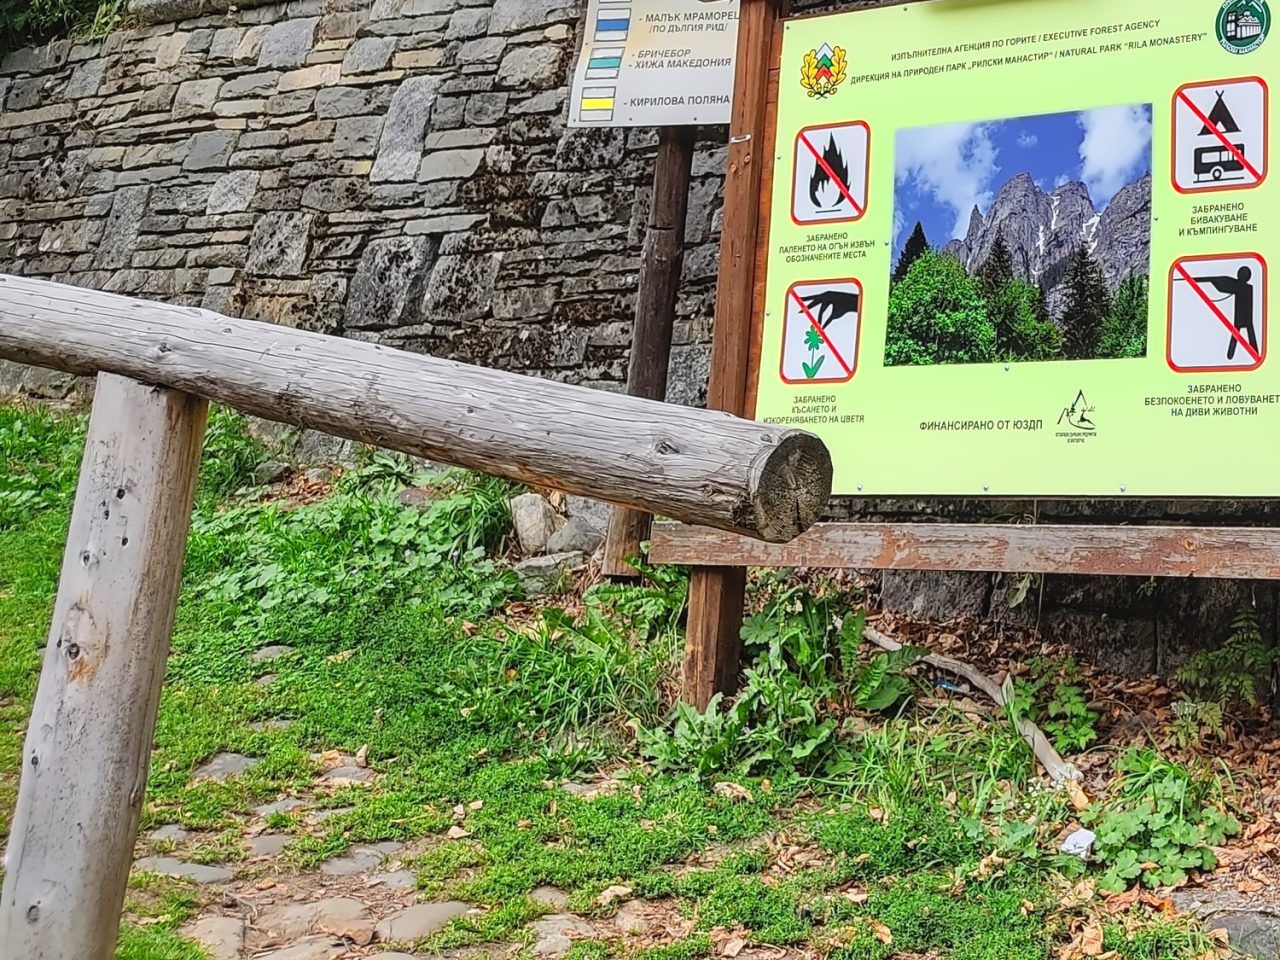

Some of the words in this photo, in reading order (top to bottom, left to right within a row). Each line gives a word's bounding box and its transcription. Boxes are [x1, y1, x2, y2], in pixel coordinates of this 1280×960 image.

[645, 13, 680, 22] МАЛЪК
[668, 24, 703, 33] ДЪЛГИЯ
[891, 46, 952, 62] ИЗПЪЛНИТЕЛНА
[953, 41, 990, 55] АГЕНЦИЯ
[992, 39, 1004, 49] ПО
[1006, 35, 1037, 47] ГОРИТЕ
[1043, 29, 1088, 42] EXECUTIVE
[1090, 24, 1123, 35] FOREST
[1125, 20, 1160, 32] AGENCY
[637, 49, 690, 58] БРИЧЕБОР
[634, 60, 664, 69] ХИЖА
[666, 58, 731, 68] МАКЕДОНИЯ
[850, 72, 890, 85] ДИРЕКЦИЯ
[891, 69, 902, 79] НА
[903, 65, 945, 78] ПРИРОДЕН
[946, 62, 967, 72] ПАРК
[1059, 46, 1098, 58] NATURAL
[1099, 43, 1122, 54] PARK
[630, 96, 685, 107] КИРИЛОВА
[689, 95, 730, 105] ПОЛЯНА
[1192, 202, 1244, 214] ЗАБРАНЕНО
[1190, 213, 1248, 225] БИВАКУВАНЕ
[1179, 228, 1185, 236] И
[1186, 223, 1258, 236] КЪМПИНГУВАНЕ
[807, 232, 848, 242] ЗАБРАНЕНО
[779, 245, 816, 254] ПАЛЕНЕТО
[817, 243, 827, 251] НА
[828, 242, 848, 250] ОГЪН
[850, 240, 875, 249] ИЗВЪН
[786, 252, 841, 263] ОБОЗНАЧЕНИТЕ
[843, 251, 867, 259] МЕСТА
[1188, 384, 1242, 393] ЗАБРАНЕНО
[793, 395, 836, 404] ЗАБРАНЕНО
[1145, 396, 1215, 406] БЕЗПОКОЕНЕТО
[1217, 396, 1223, 404] И
[791, 406, 830, 414] КЪСАНЕТО
[1171, 408, 1183, 417] НА
[1185, 408, 1210, 417] ДИВИ
[1212, 407, 1258, 416] ЖИВОТНИ
[829, 415, 839, 423] НА
[840, 415, 865, 423] ЦВЕТЯ
[920, 420, 994, 431] ФИНАНСИРАНО
[997, 420, 1010, 429] ОТ
[1013, 420, 1043, 431] ЮЗДП
